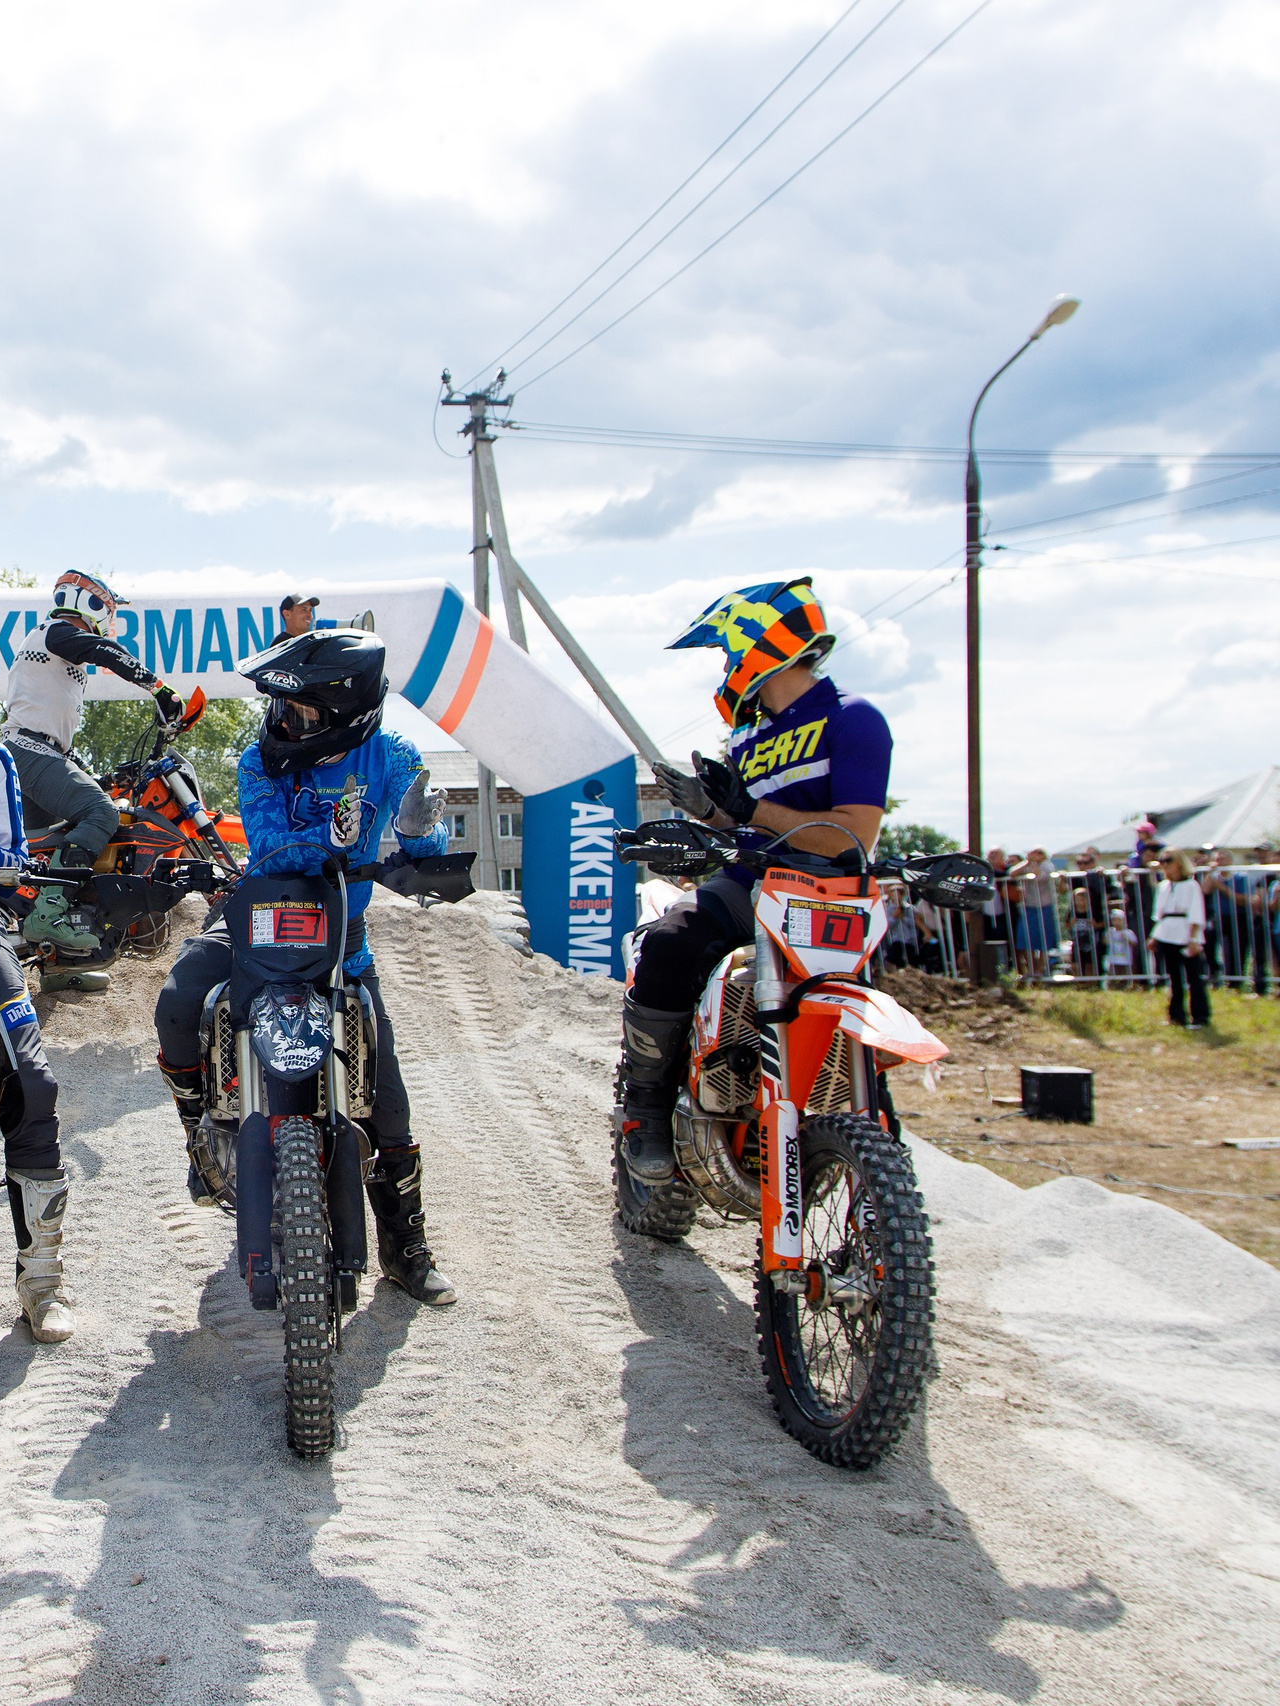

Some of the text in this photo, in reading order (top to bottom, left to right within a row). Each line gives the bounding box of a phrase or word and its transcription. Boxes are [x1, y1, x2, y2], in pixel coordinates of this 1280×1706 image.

[262, 671, 298, 688] Airoh
[14, 736, 49, 753] VECTOR
[738, 716, 828, 782] LEATT
[769, 871, 815, 887] DUNIN IGOR
[569, 896, 613, 910] cement
[277, 913, 320, 938] 3
[823, 916, 851, 944] 1
[274, 1054, 318, 1063] ENDURO
[786, 1135, 798, 1210] MOTOREX
